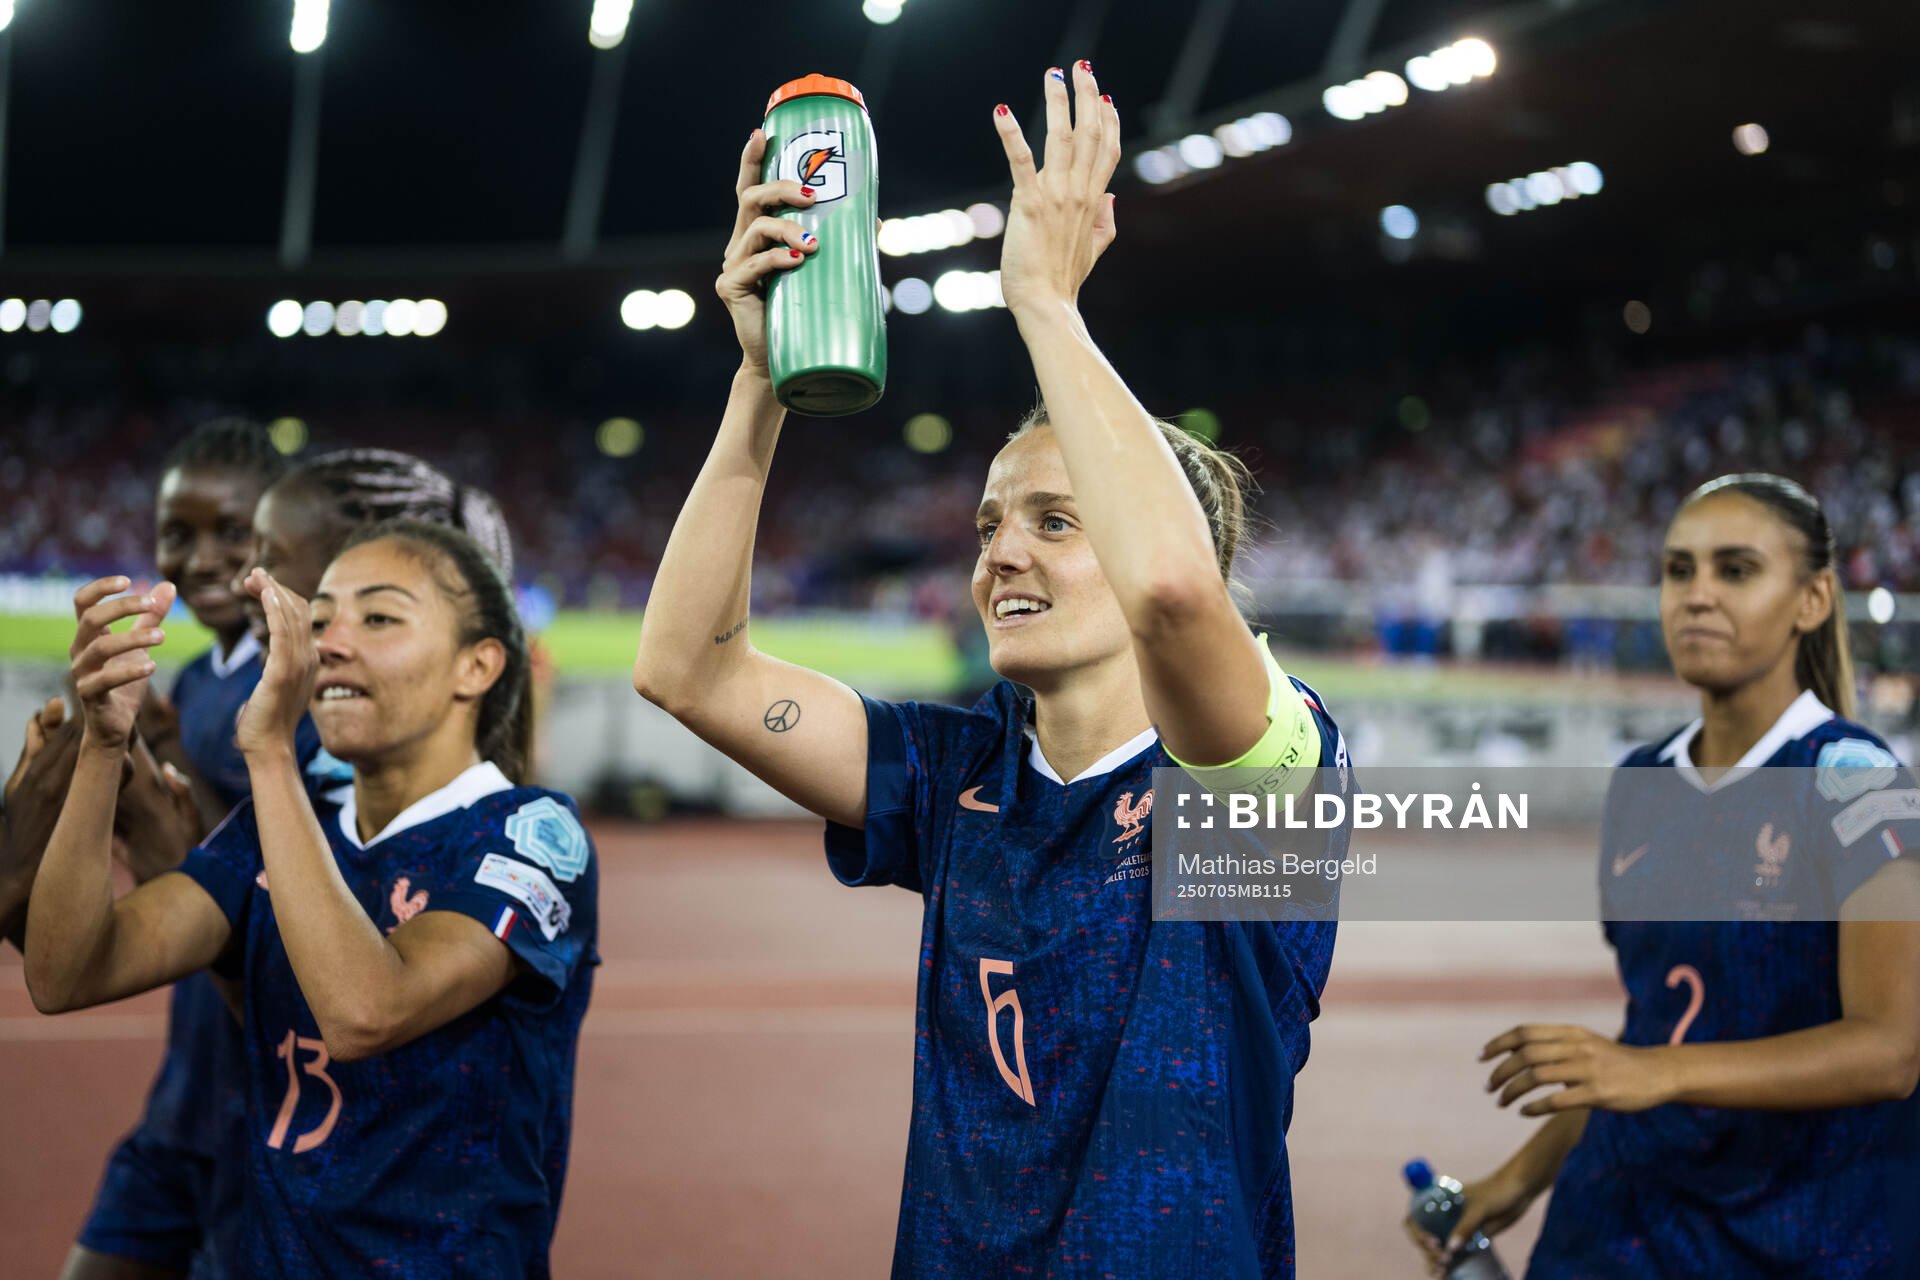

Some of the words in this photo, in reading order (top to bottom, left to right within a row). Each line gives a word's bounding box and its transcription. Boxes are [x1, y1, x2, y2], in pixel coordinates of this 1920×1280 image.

[777, 130, 848, 204] G
[1129, 866, 1150, 879] 2025
[979, 957, 1036, 1107] 6
[1665, 963, 1705, 1047] 2
[267, 1028, 343, 1154] 13
